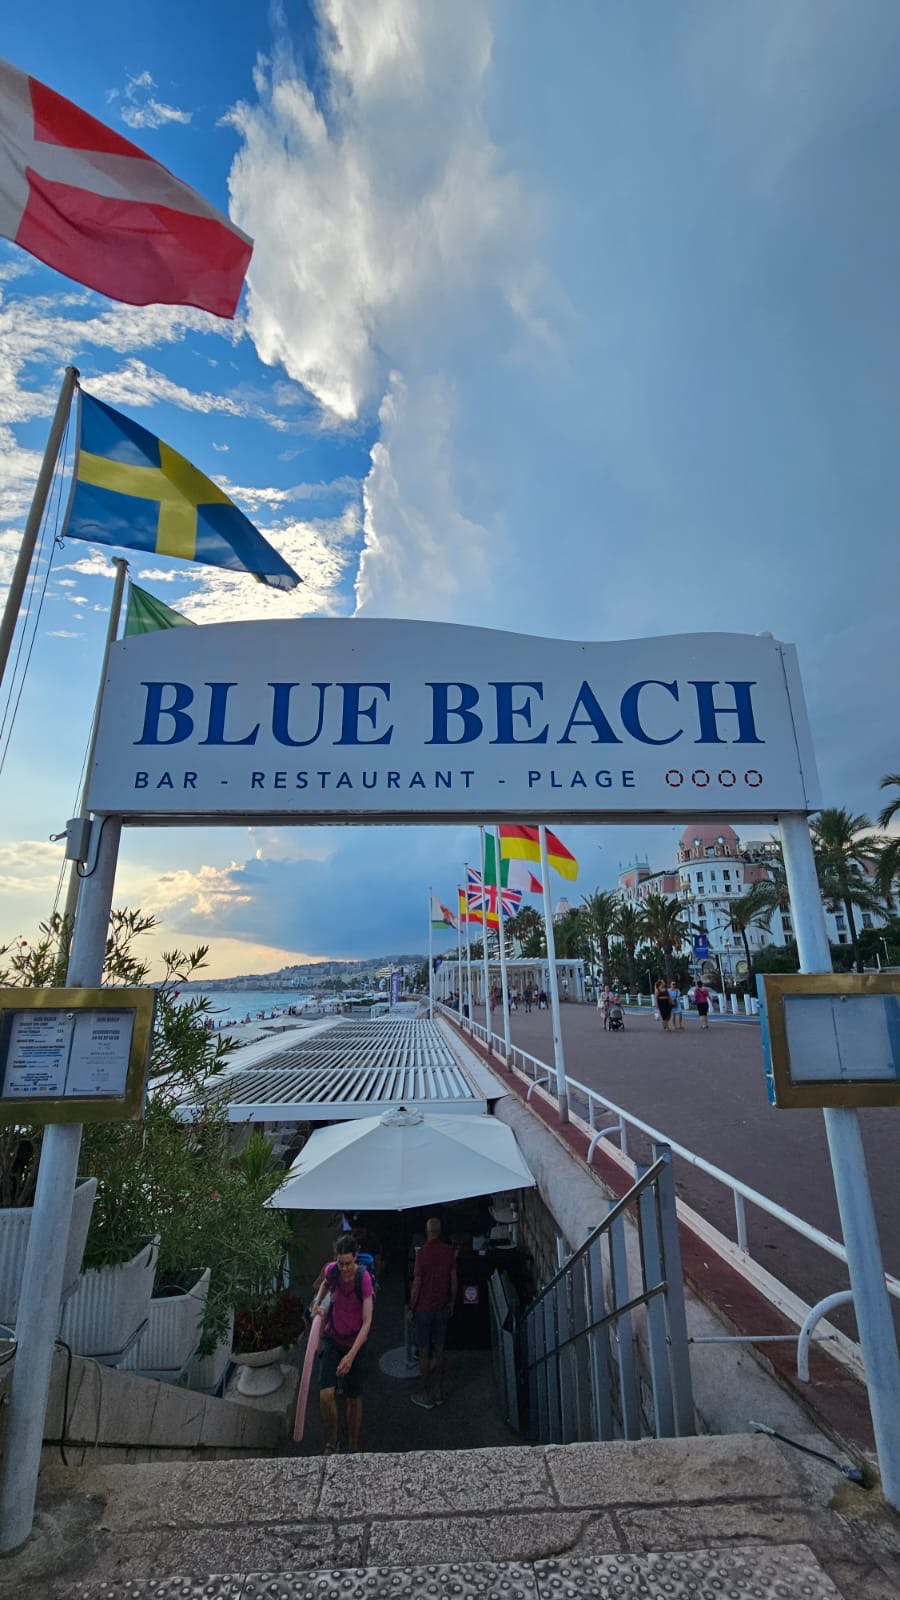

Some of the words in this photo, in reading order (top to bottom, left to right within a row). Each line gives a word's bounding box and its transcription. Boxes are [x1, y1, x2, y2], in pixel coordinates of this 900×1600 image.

[132, 681, 395, 747] BLUE
[424, 679, 767, 746] BEACH
[134, 771, 199, 790] BAR
[250, 770, 475, 790] RESTAURANT
[527, 769, 636, 789] PLAGE
